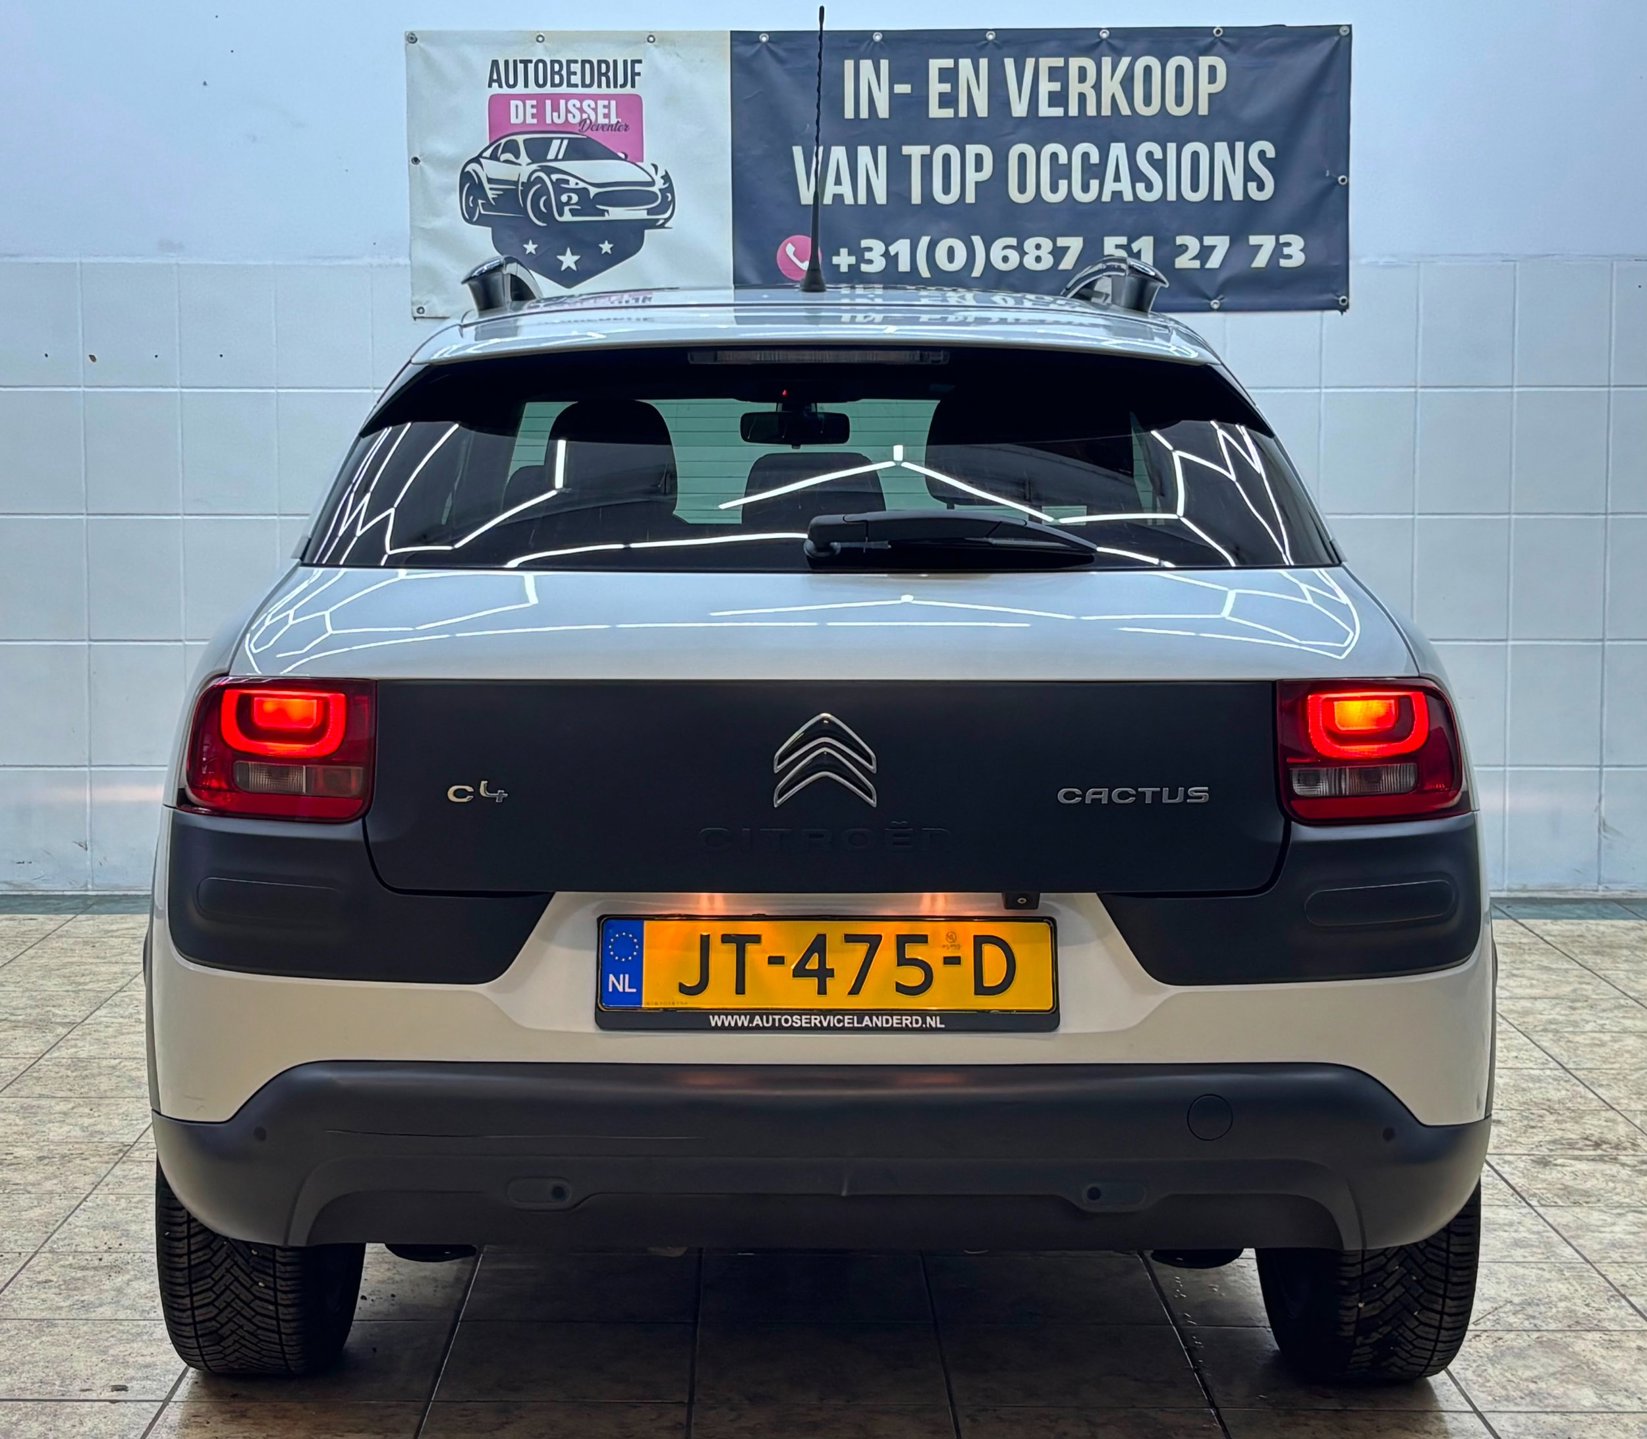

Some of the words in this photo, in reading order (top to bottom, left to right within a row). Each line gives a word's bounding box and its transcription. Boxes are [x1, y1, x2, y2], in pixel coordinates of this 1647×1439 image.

[488, 59, 642, 88] AUTOBEDRIJF
[843, 59, 911, 118] IN-
[929, 57, 989, 118] EN
[1004, 56, 1228, 117] VERKOOP
[510, 100, 538, 124] DE
[545, 99, 620, 124] IJSSEL
[578, 118, 630, 133] Deventer
[792, 145, 887, 205] VAN
[902, 143, 993, 204] TOP
[1007, 141, 1276, 204] OCCASIONS
[1174, 235, 1230, 269] 27
[1248, 234, 1306, 269] 73
[447, 780, 508, 802] C4
[1057, 786, 1210, 804] CACTUS
[678, 933, 1016, 996] JT-475-D
[608, 973, 637, 993] NL
[709, 1014, 946, 1029] WWW.AUTOSERVICELANDERD.NL
